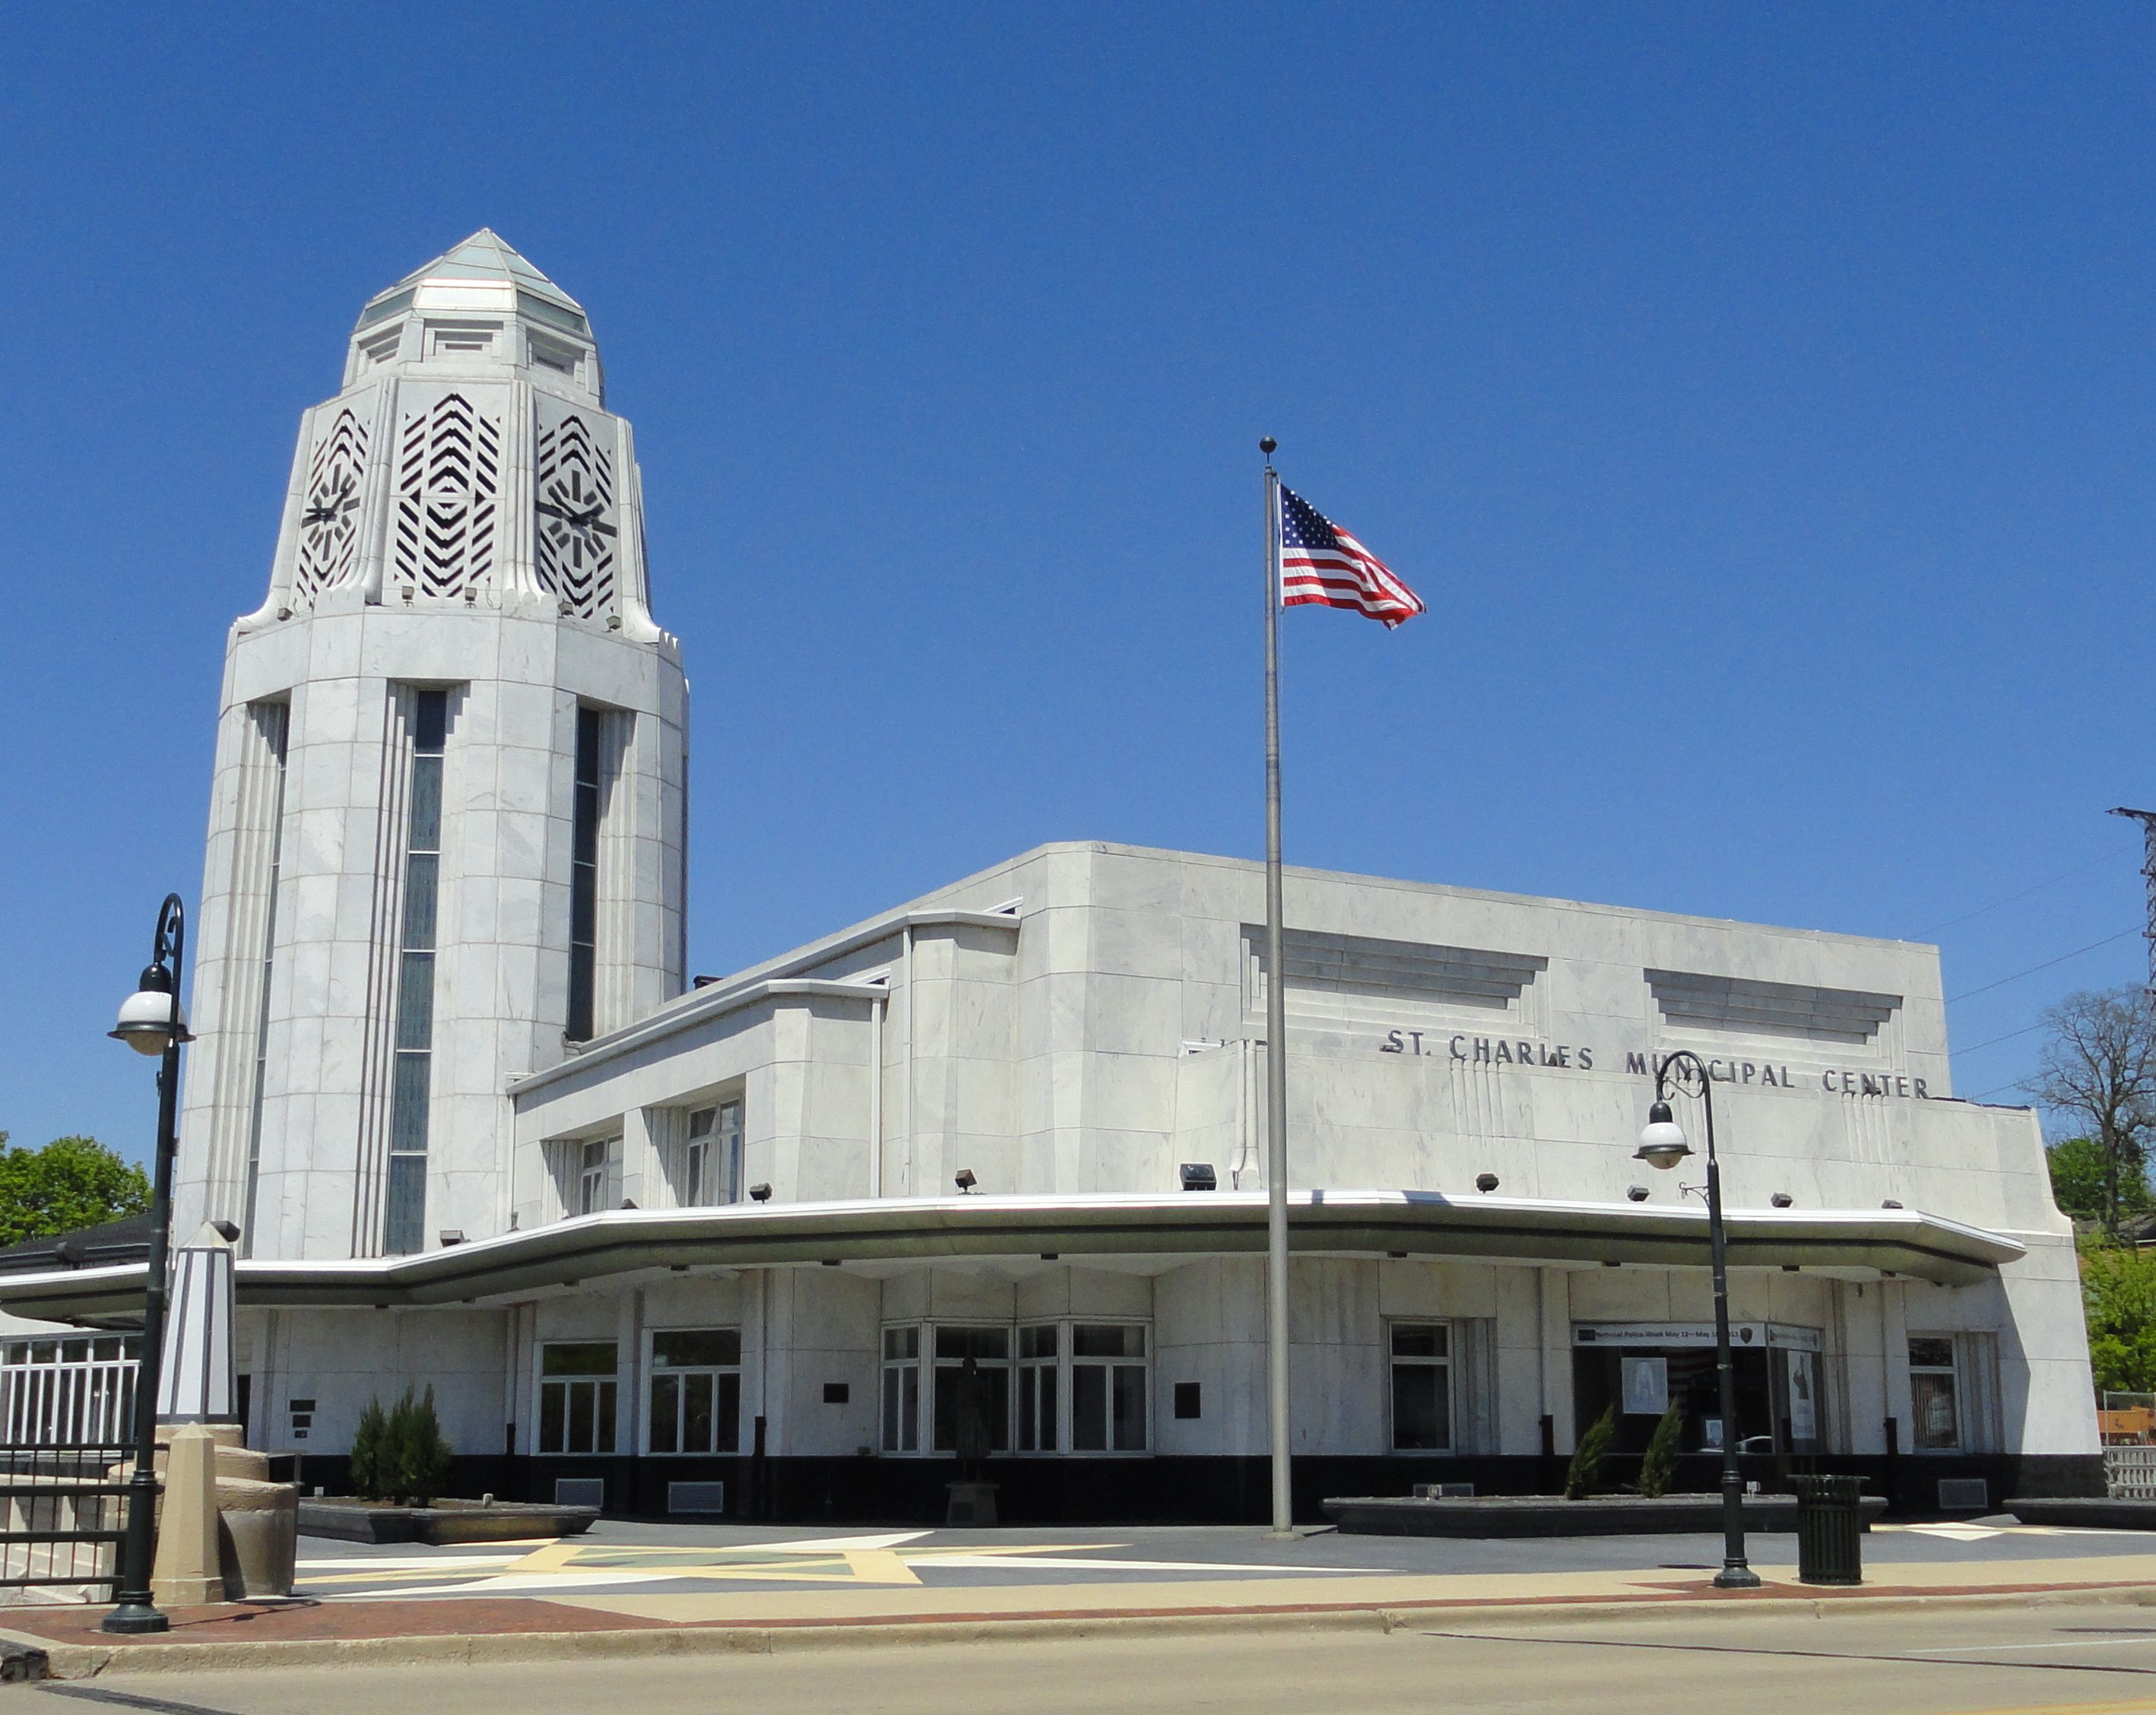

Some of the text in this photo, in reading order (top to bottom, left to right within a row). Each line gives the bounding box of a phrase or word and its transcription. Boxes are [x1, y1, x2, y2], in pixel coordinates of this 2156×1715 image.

[1385, 1029, 1929, 1099] ST. CHARLES MUNCIPAL CENTER
